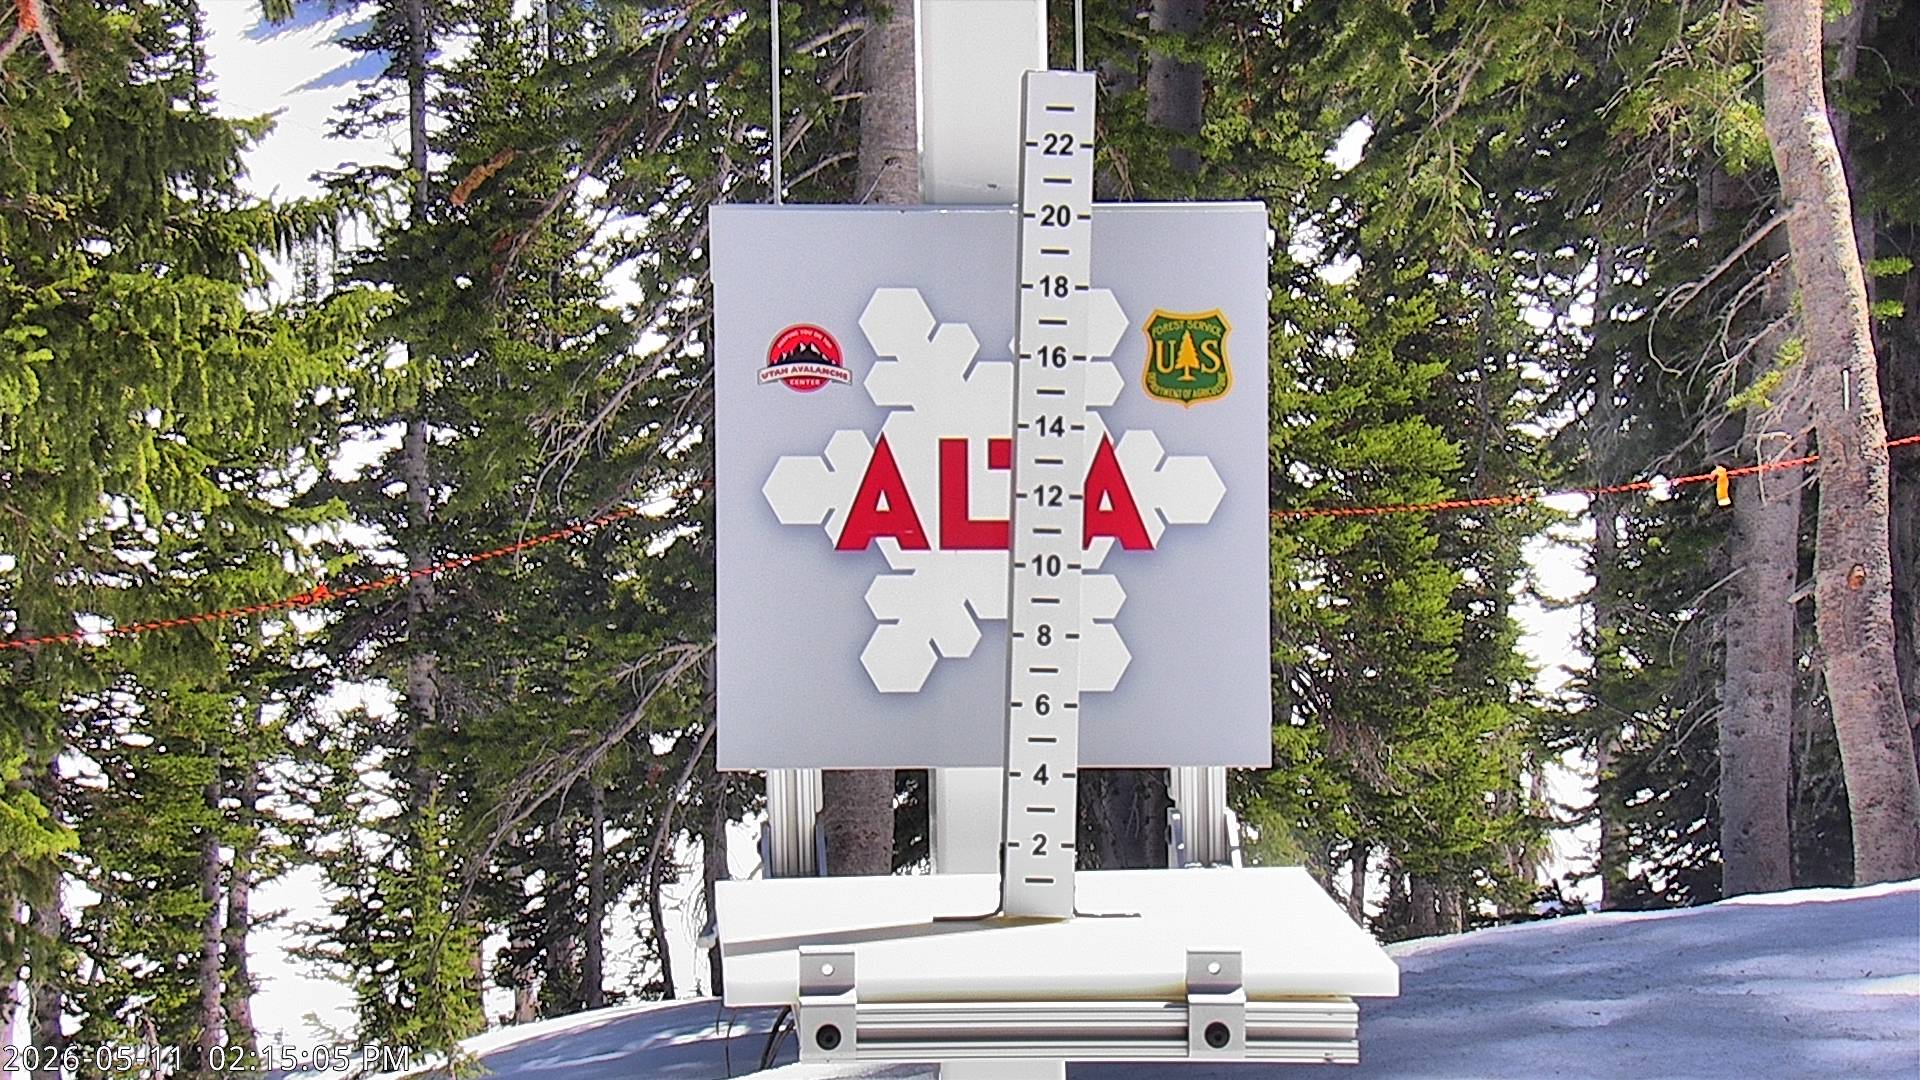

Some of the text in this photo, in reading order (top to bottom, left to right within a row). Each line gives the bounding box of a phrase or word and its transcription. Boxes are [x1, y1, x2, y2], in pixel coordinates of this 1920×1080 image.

[1043, 133, 1074, 156] 22
[1040, 204, 1071, 228] 20
[1039, 275, 1069, 298] 18
[1152, 320, 1184, 338] FOREST
[1037, 345, 1067, 369] 16
[761, 365, 849, 381] UTAH AVALANCHE
[789, 378, 820, 386] CENTER
[1035, 415, 1065, 437] 14
[1033, 484, 1063, 507] 12
[1031, 554, 1061, 577] 10
[1037, 624, 1052, 647] 8
[1035, 693, 1050, 716] 6
[1033, 763, 1048, 786] 4
[1032, 833, 1047, 856] 2
